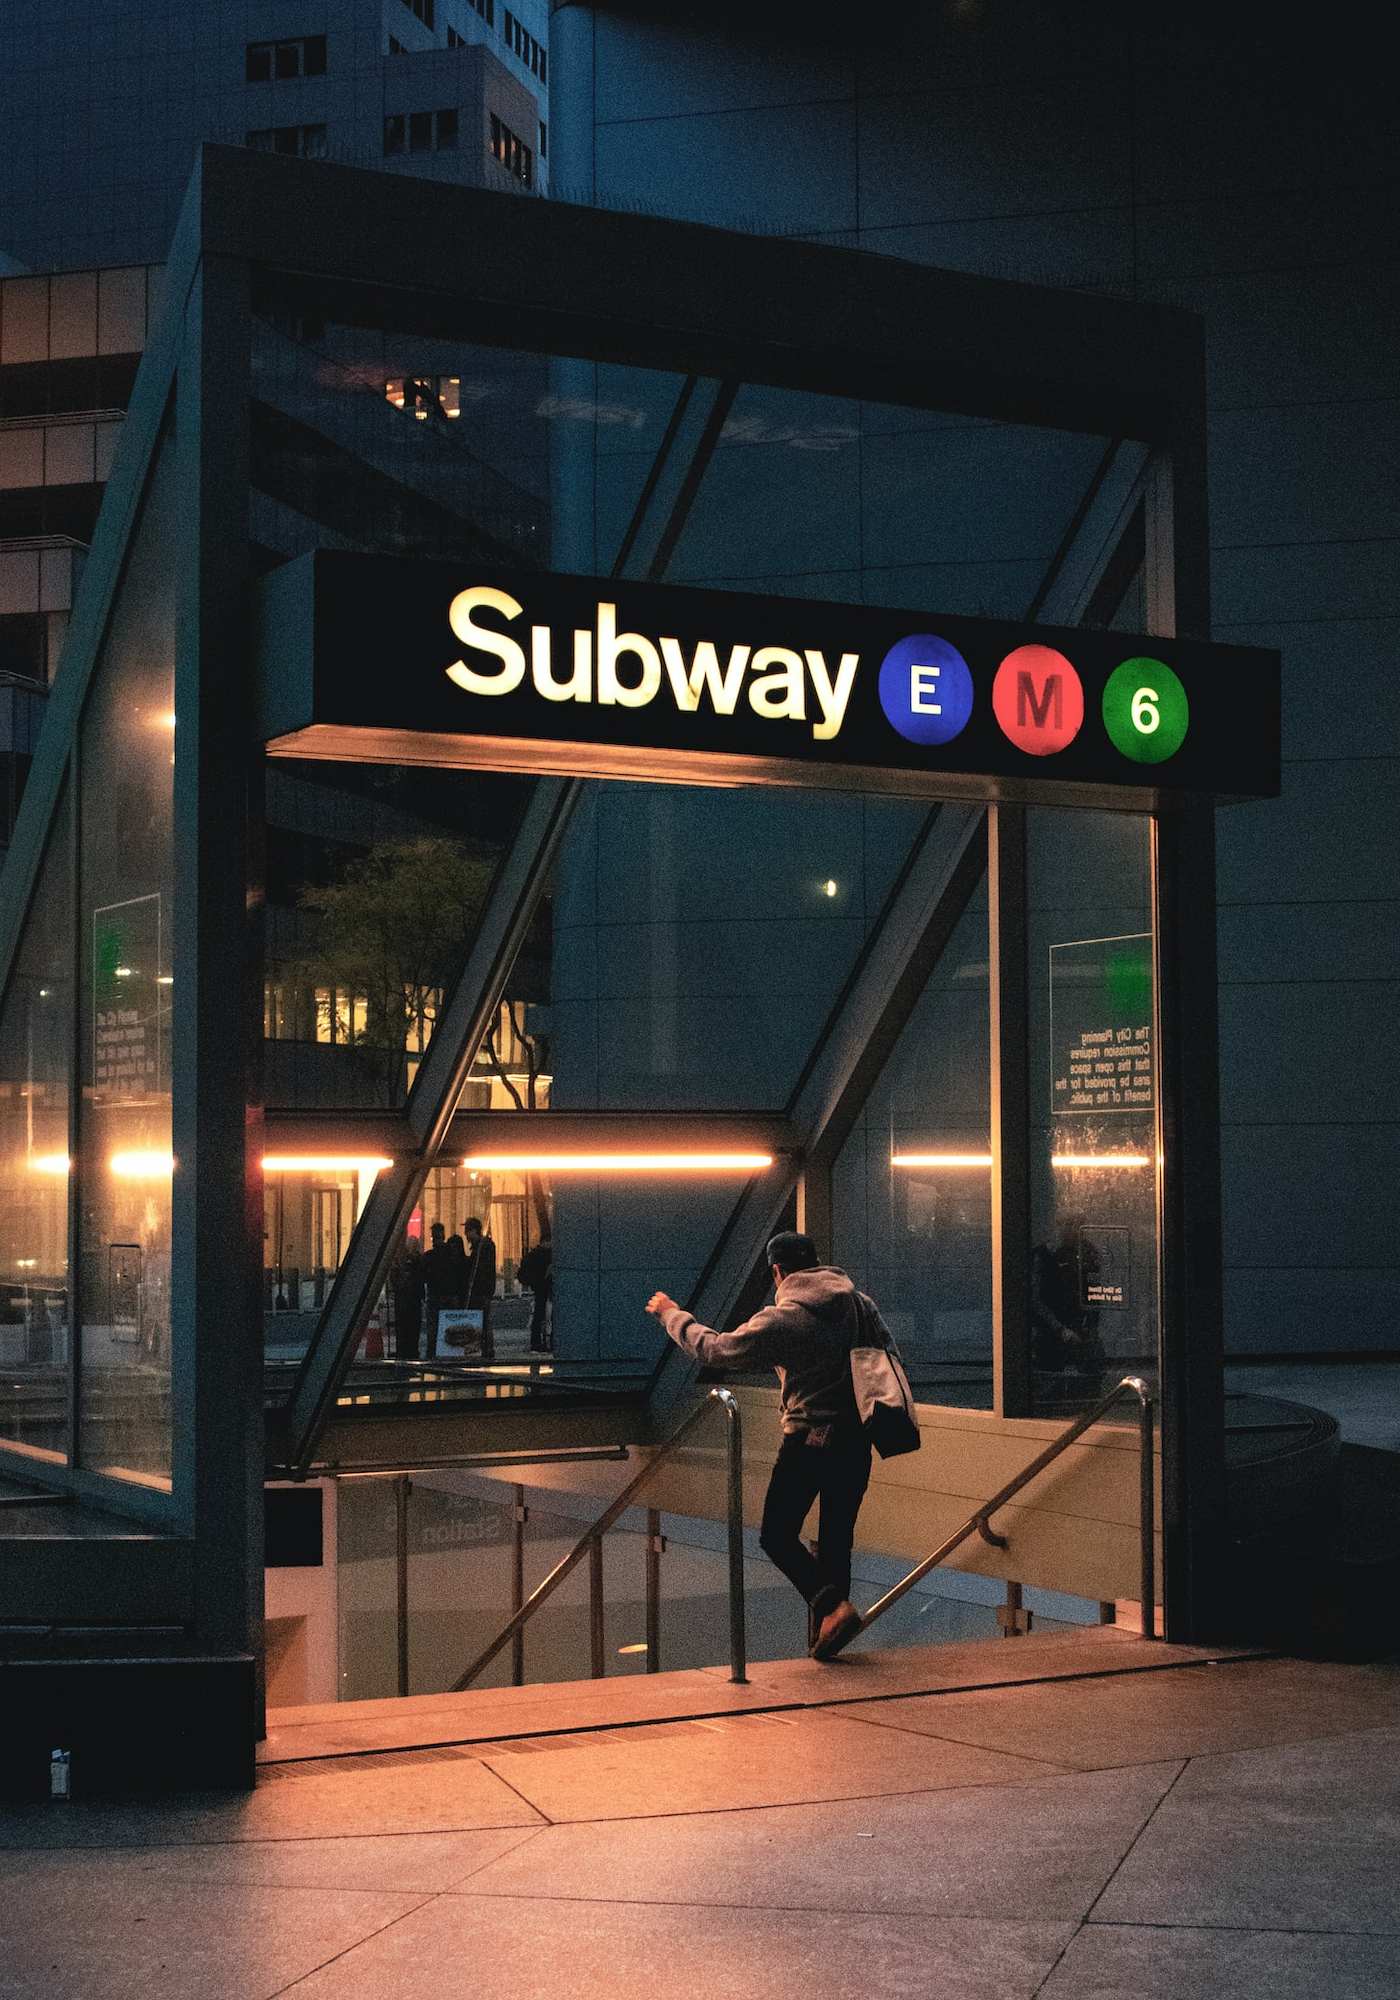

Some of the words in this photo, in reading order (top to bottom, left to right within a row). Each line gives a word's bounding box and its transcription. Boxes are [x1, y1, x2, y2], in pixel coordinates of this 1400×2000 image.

[445, 586, 860, 740] Subway
[910, 664, 942, 715] E
[1016, 671, 1063, 729] M
[1131, 687, 1160, 734] 6
